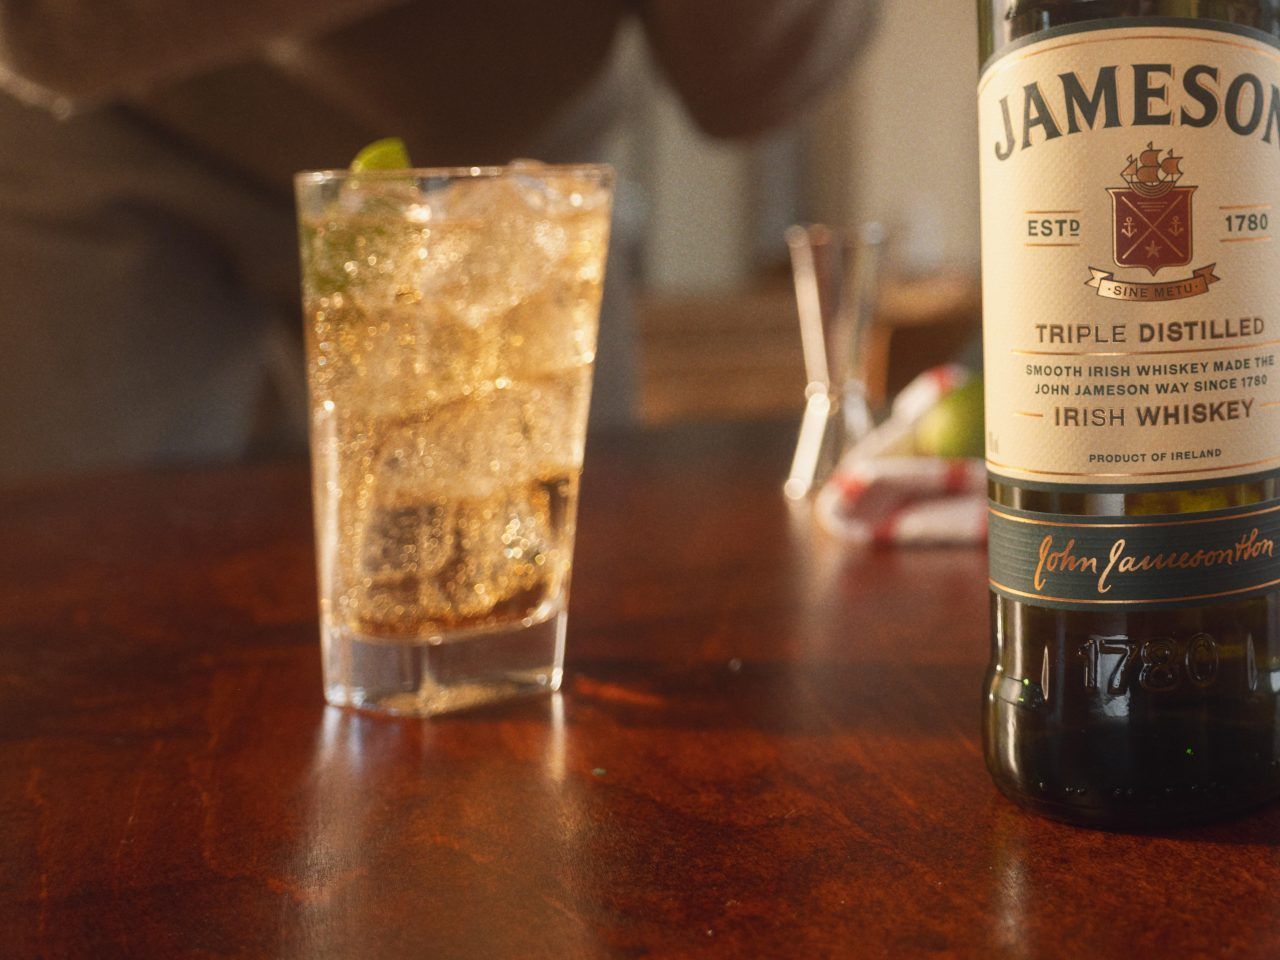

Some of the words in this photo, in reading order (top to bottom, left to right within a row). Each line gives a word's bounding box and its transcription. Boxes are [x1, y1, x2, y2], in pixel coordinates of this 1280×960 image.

[1225, 213, 1268, 233] 1780
[1113, 285, 1148, 299] SINE
[1154, 284, 1193, 299] METU
[1035, 323, 1126, 345] TRIPLE
[1139, 317, 1265, 343] DISTILLED
[1026, 364, 1083, 378] SMOOTH
[1088, 366, 1131, 378] IRISH
[1136, 361, 1209, 377] WHISKEY
[1213, 358, 1251, 373] MADE
[1254, 354, 1275, 369] THE
[1035, 383, 1070, 396] JOHN
[1075, 383, 1150, 396] JAMESON
[1155, 382, 1189, 395] WAY
[1194, 377, 1238, 393] SINCE
[1241, 373, 1268, 388] 1780
[1054, 406, 1126, 428] IRISH
[1136, 398, 1256, 428] WHISKEY
[1089, 452, 1147, 463] PRODUCT
[1151, 452, 1168, 463] OF
[1171, 448, 1222, 462] IRELAND
[1033, 534, 1098, 591] John
[1076, 631, 1219, 696] 1780
